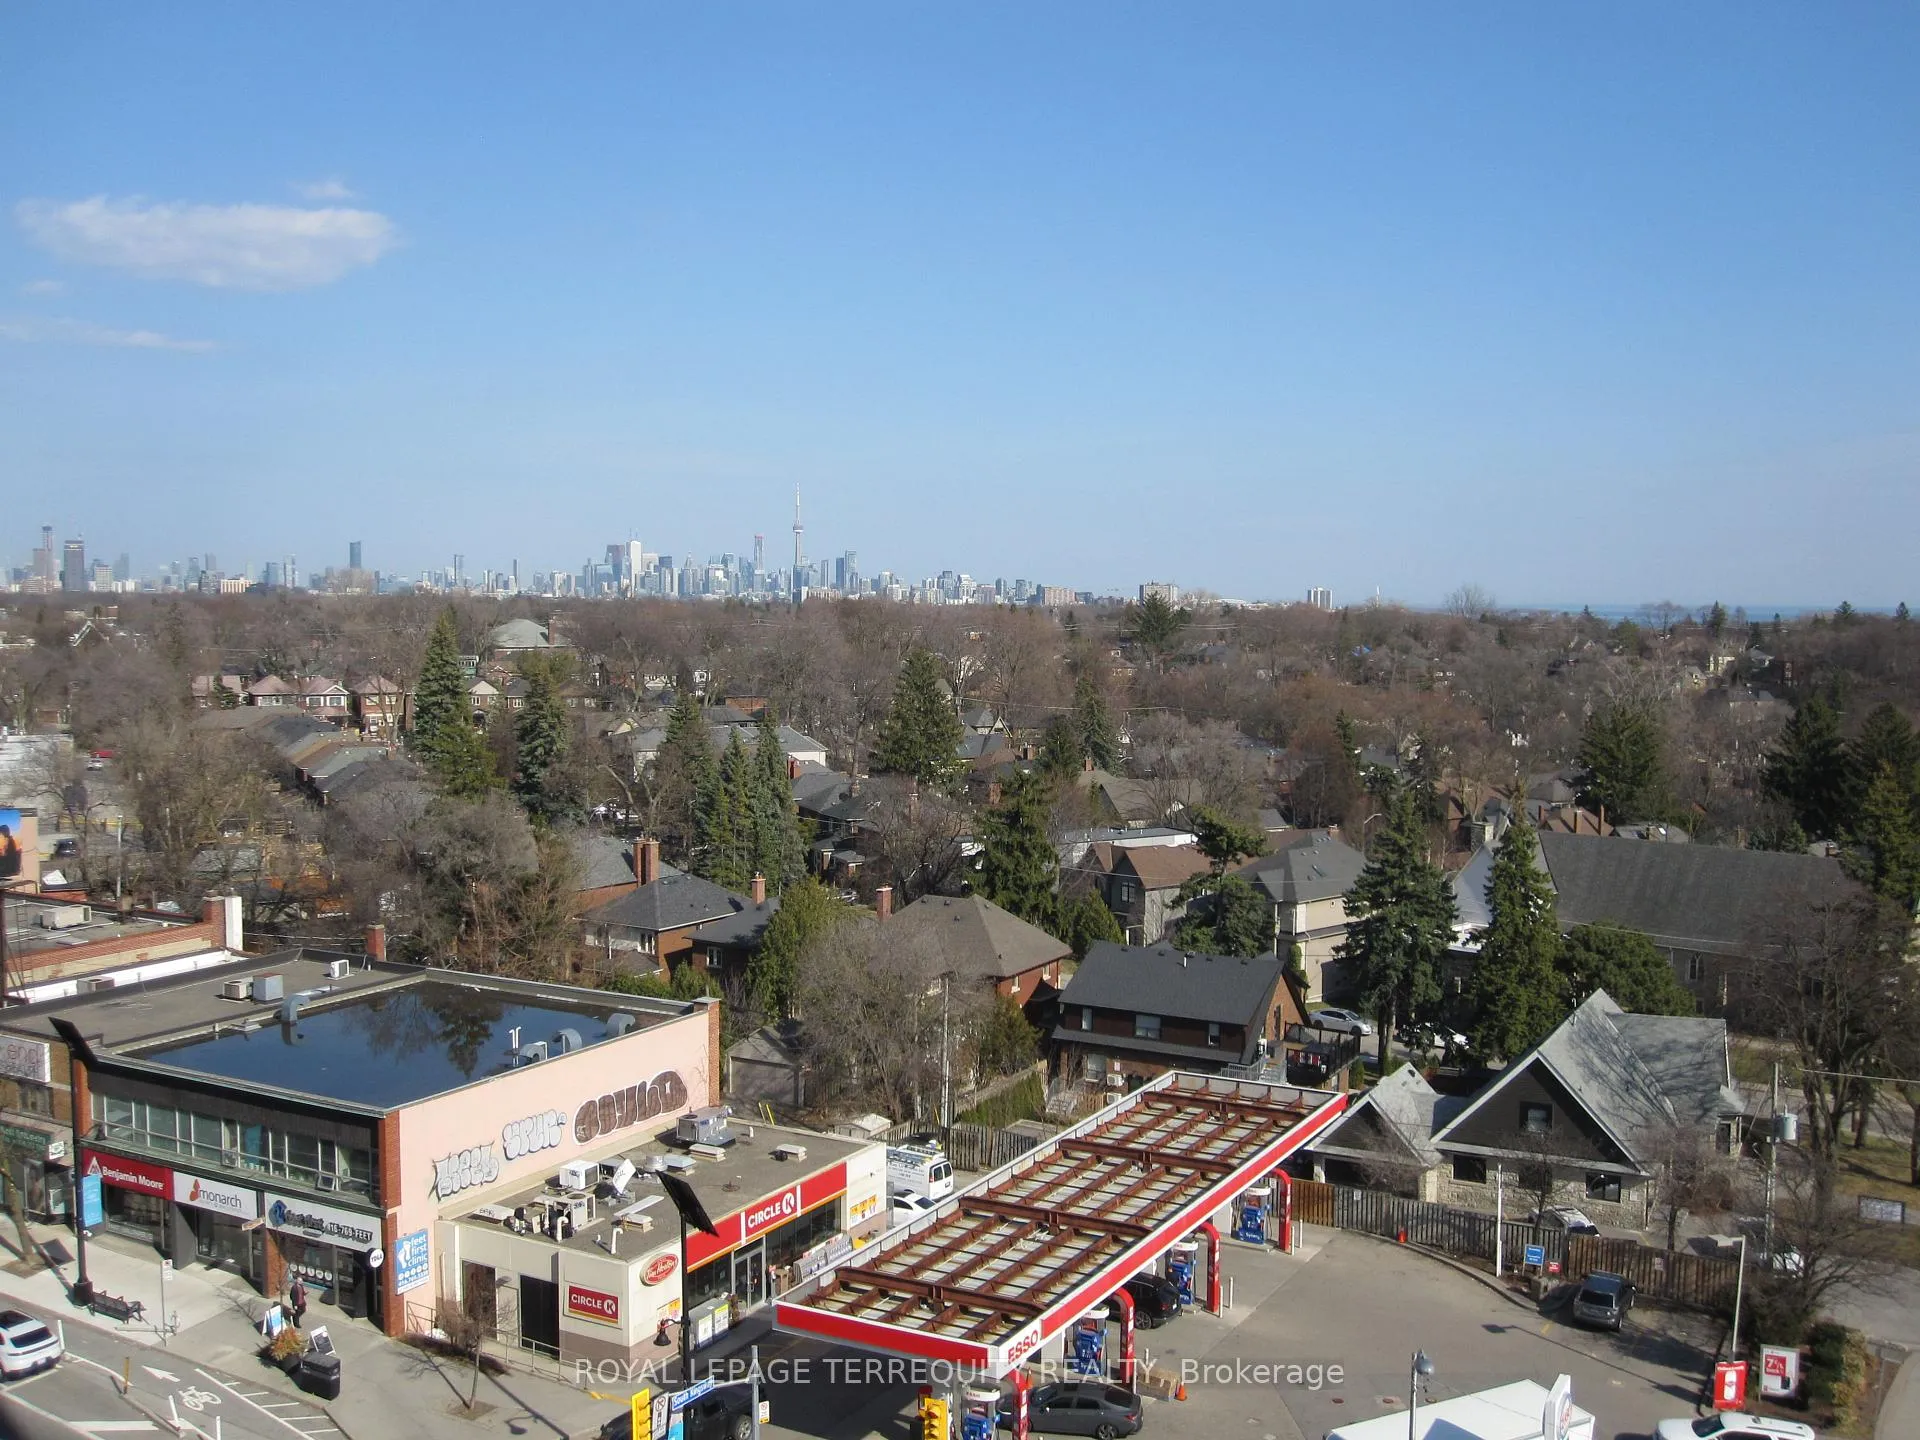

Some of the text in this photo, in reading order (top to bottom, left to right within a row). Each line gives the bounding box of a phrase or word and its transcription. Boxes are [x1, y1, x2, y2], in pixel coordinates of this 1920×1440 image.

[102, 1166, 164, 1190] Benjamin Moore
[200, 1190, 242, 1209] monarch
[748, 1192, 795, 1228] CIRCLE K
[411, 1234, 426, 1247] feet
[411, 1243, 427, 1257] first
[408, 1253, 428, 1266] clinic
[571, 1294, 616, 1315] CIRCLE K
[1008, 1330, 1038, 1364] ESSO
[673, 1378, 714, 1405] South Kingsway
